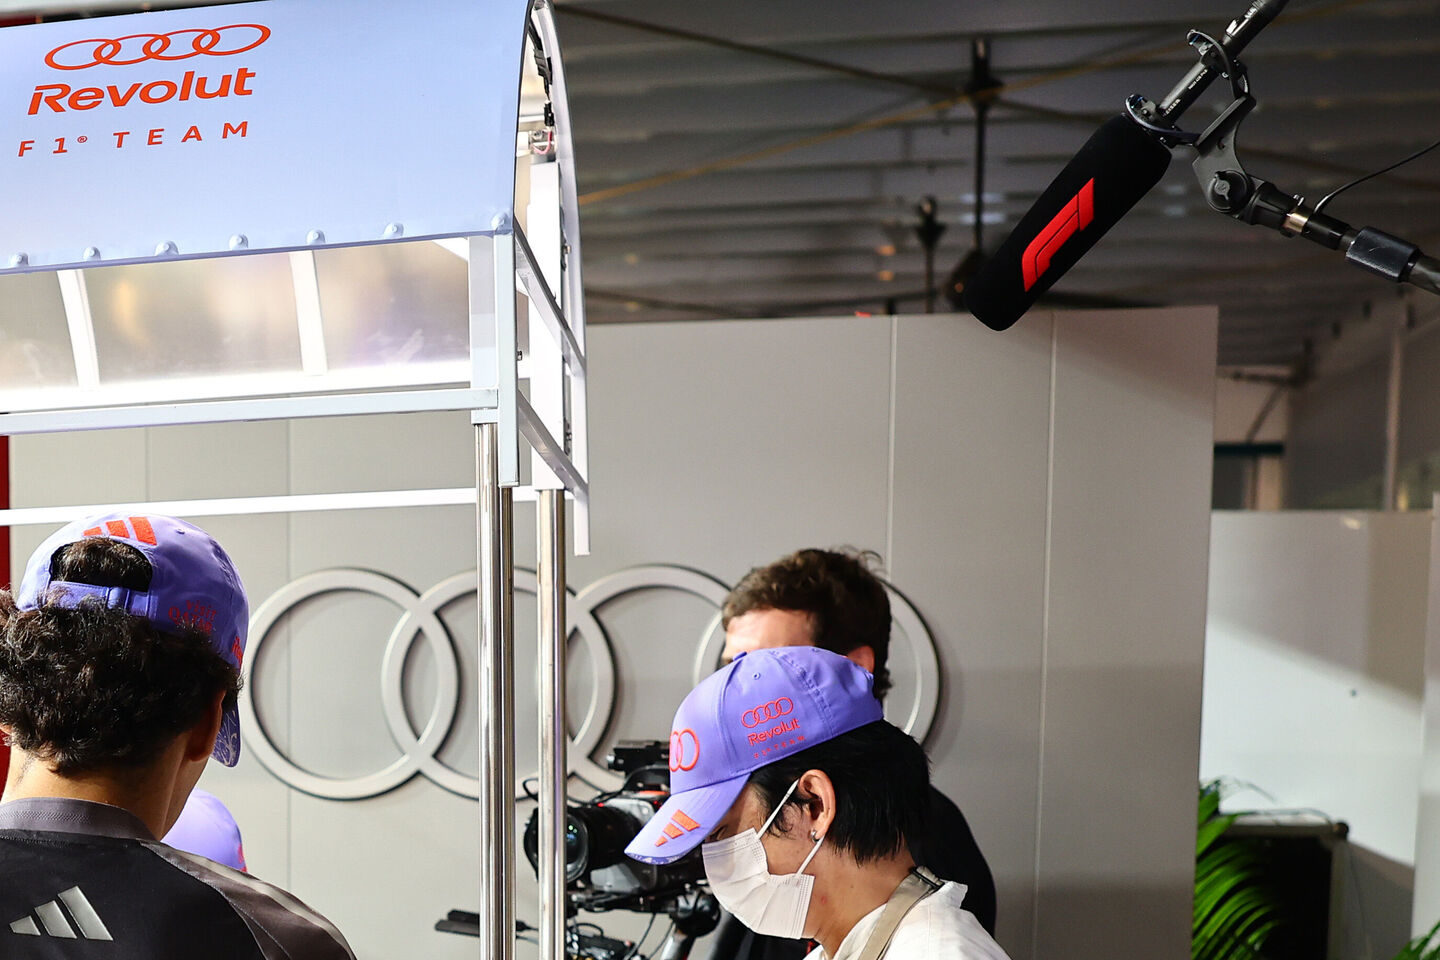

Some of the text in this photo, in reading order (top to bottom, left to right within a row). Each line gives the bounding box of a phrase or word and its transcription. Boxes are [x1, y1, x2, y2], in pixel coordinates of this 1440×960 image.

[27, 68, 255, 116] Revolut
[113, 121, 248, 149] TEAM
[747, 718, 800, 746] Revolut
